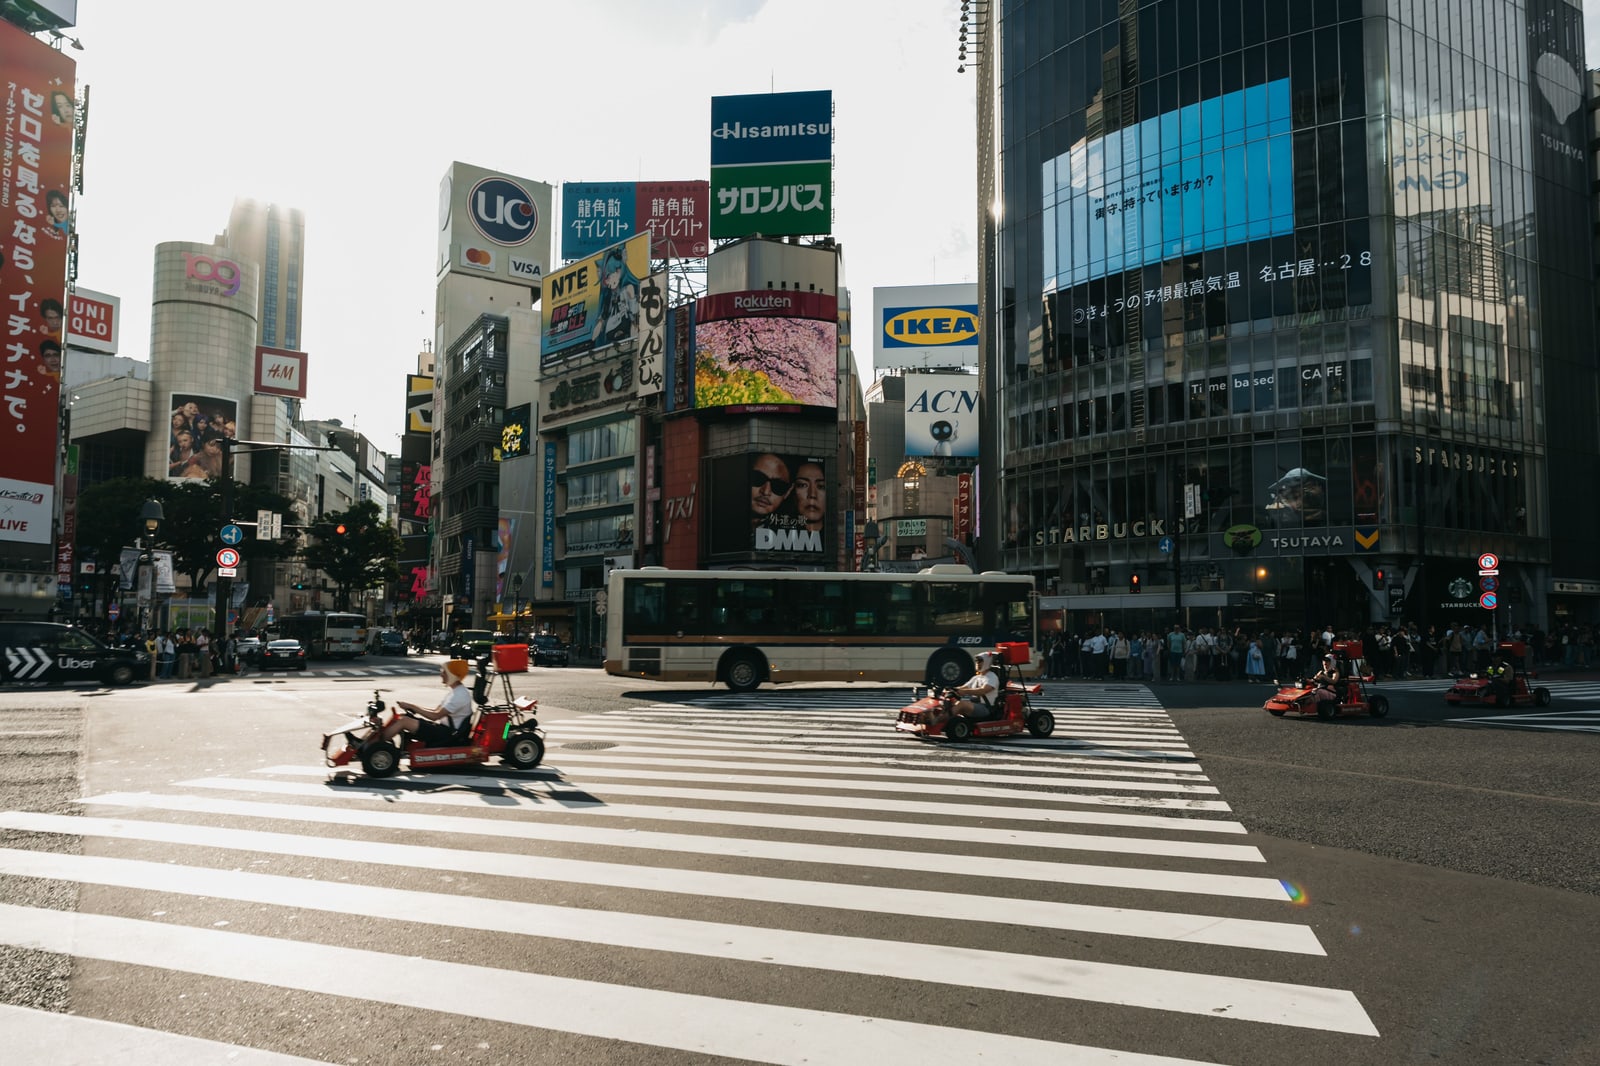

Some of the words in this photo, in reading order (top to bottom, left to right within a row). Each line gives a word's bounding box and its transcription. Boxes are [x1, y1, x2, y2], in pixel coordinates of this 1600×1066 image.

[713, 121, 830, 140] Hisamitsu
[1540, 133, 1584, 160] TSUTAYA
[577, 198, 621, 218] 龍角散
[652, 197, 695, 217] 龍角散
[717, 184, 824, 215] サロンパス
[571, 219, 629, 238] ダイレクト
[4, 87, 45, 434] ゼロを見るなら、イチナナで。
[512, 260, 541, 276] VISA
[182, 252, 240, 296] 109
[552, 266, 588, 300] NTE
[73, 300, 105, 320] UNI
[734, 295, 792, 309] Rakuten
[71, 316, 108, 336] QLO
[639, 278, 664, 390] もんじゃ
[893, 316, 977, 335] IKEA
[266, 362, 295, 381] H&M
[1191, 382, 1228, 394] Time
[1234, 374, 1274, 389] based
[1302, 365, 1343, 380] CAFE
[908, 389, 979, 414] ACN
[664, 482, 697, 544] クスリ
[960, 481, 969, 527] カラオケ
[755, 527, 823, 552] DMM
[1271, 535, 1344, 548] TSUTAYA
[957, 636, 982, 644] KEIO
[58, 656, 96, 670] Uber
